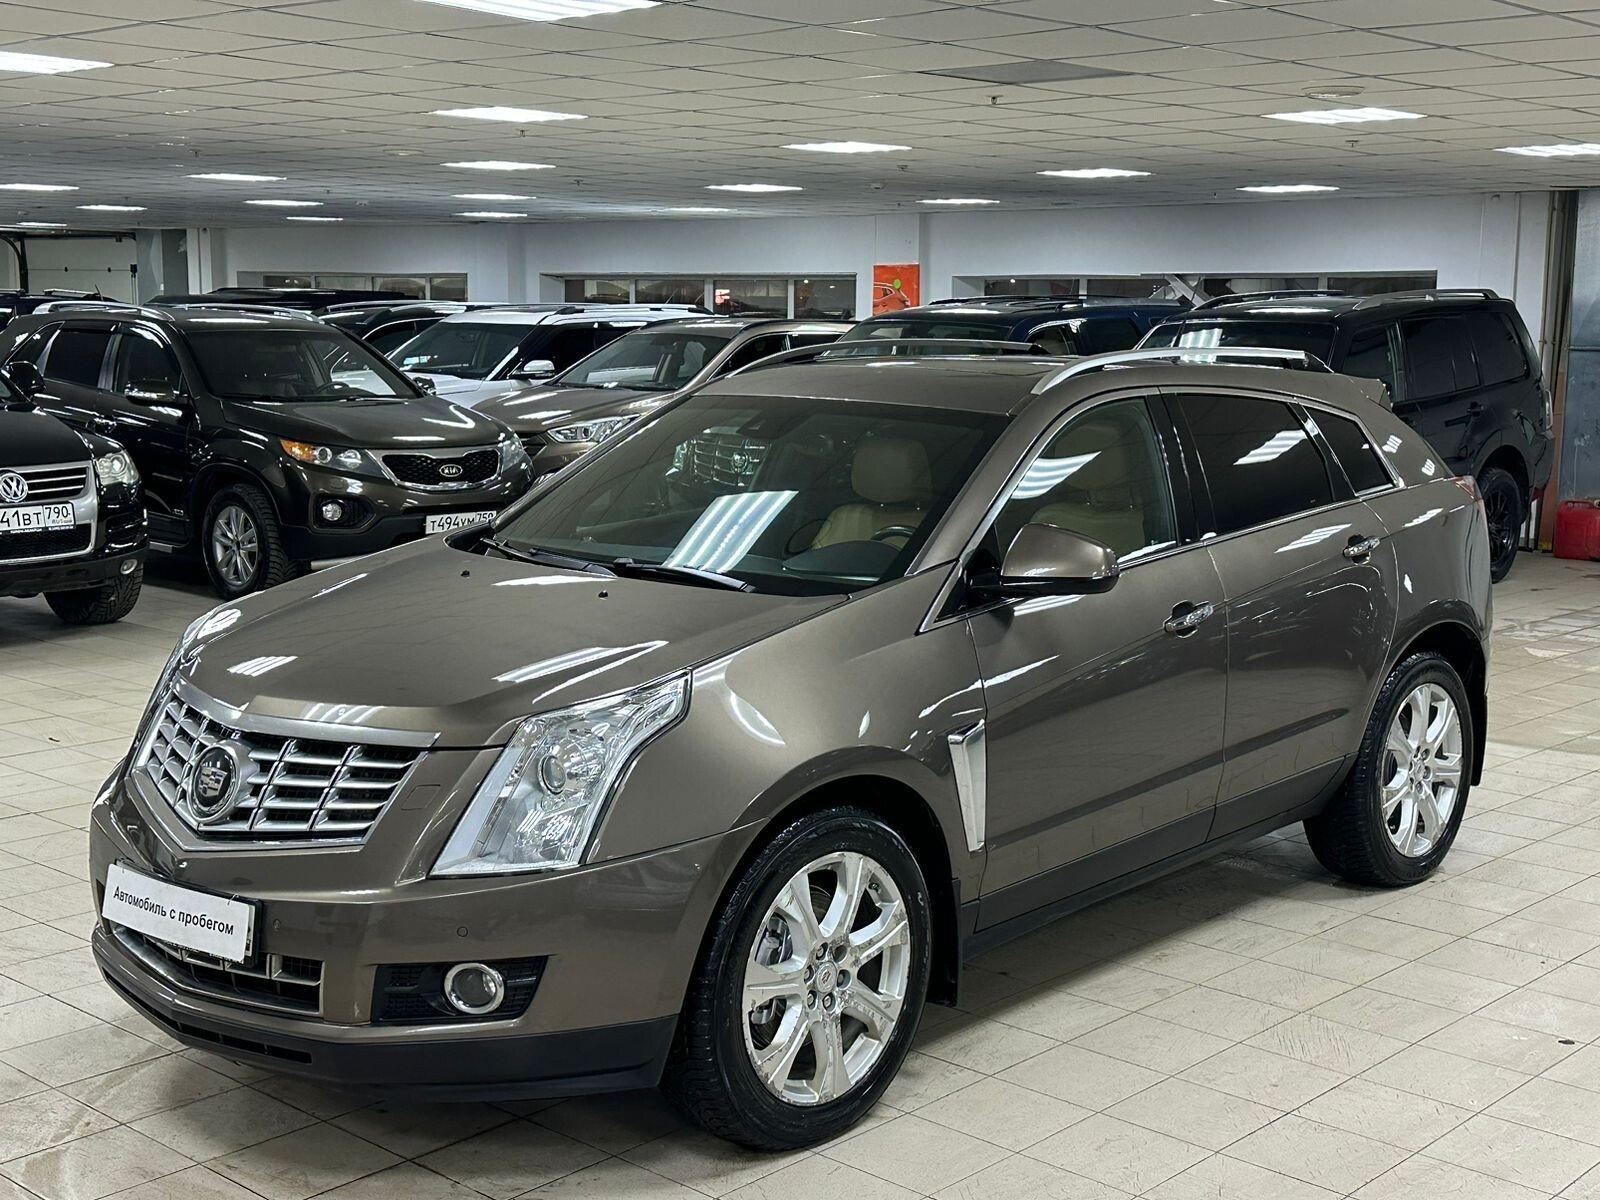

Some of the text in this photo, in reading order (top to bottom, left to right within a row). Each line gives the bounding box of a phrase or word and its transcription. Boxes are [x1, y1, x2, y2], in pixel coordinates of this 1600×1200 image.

[45, 505, 69, 520] 790
[113, 885, 234, 936] Автомобиль с пробегом
